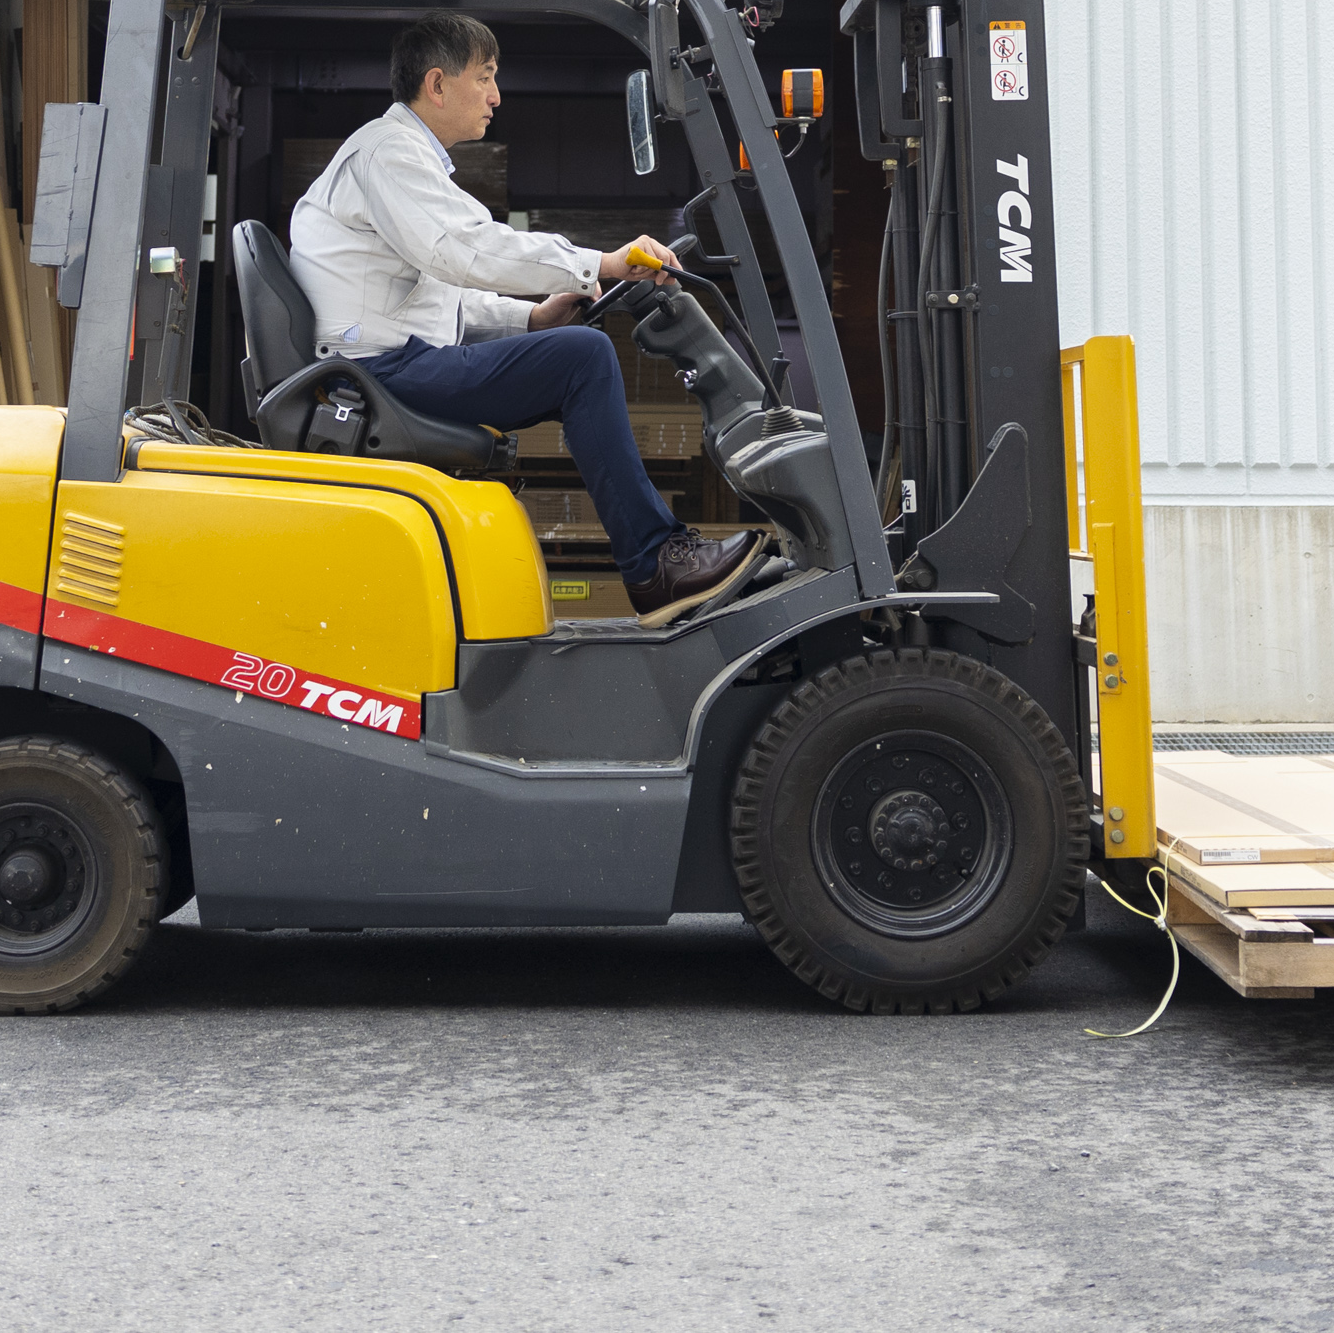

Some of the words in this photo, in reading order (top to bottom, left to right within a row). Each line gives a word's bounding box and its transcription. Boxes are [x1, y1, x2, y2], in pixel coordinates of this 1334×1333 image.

[996, 153, 1033, 283] TCM
[220, 652, 296, 698] 20
[299, 680, 404, 734] TCM
